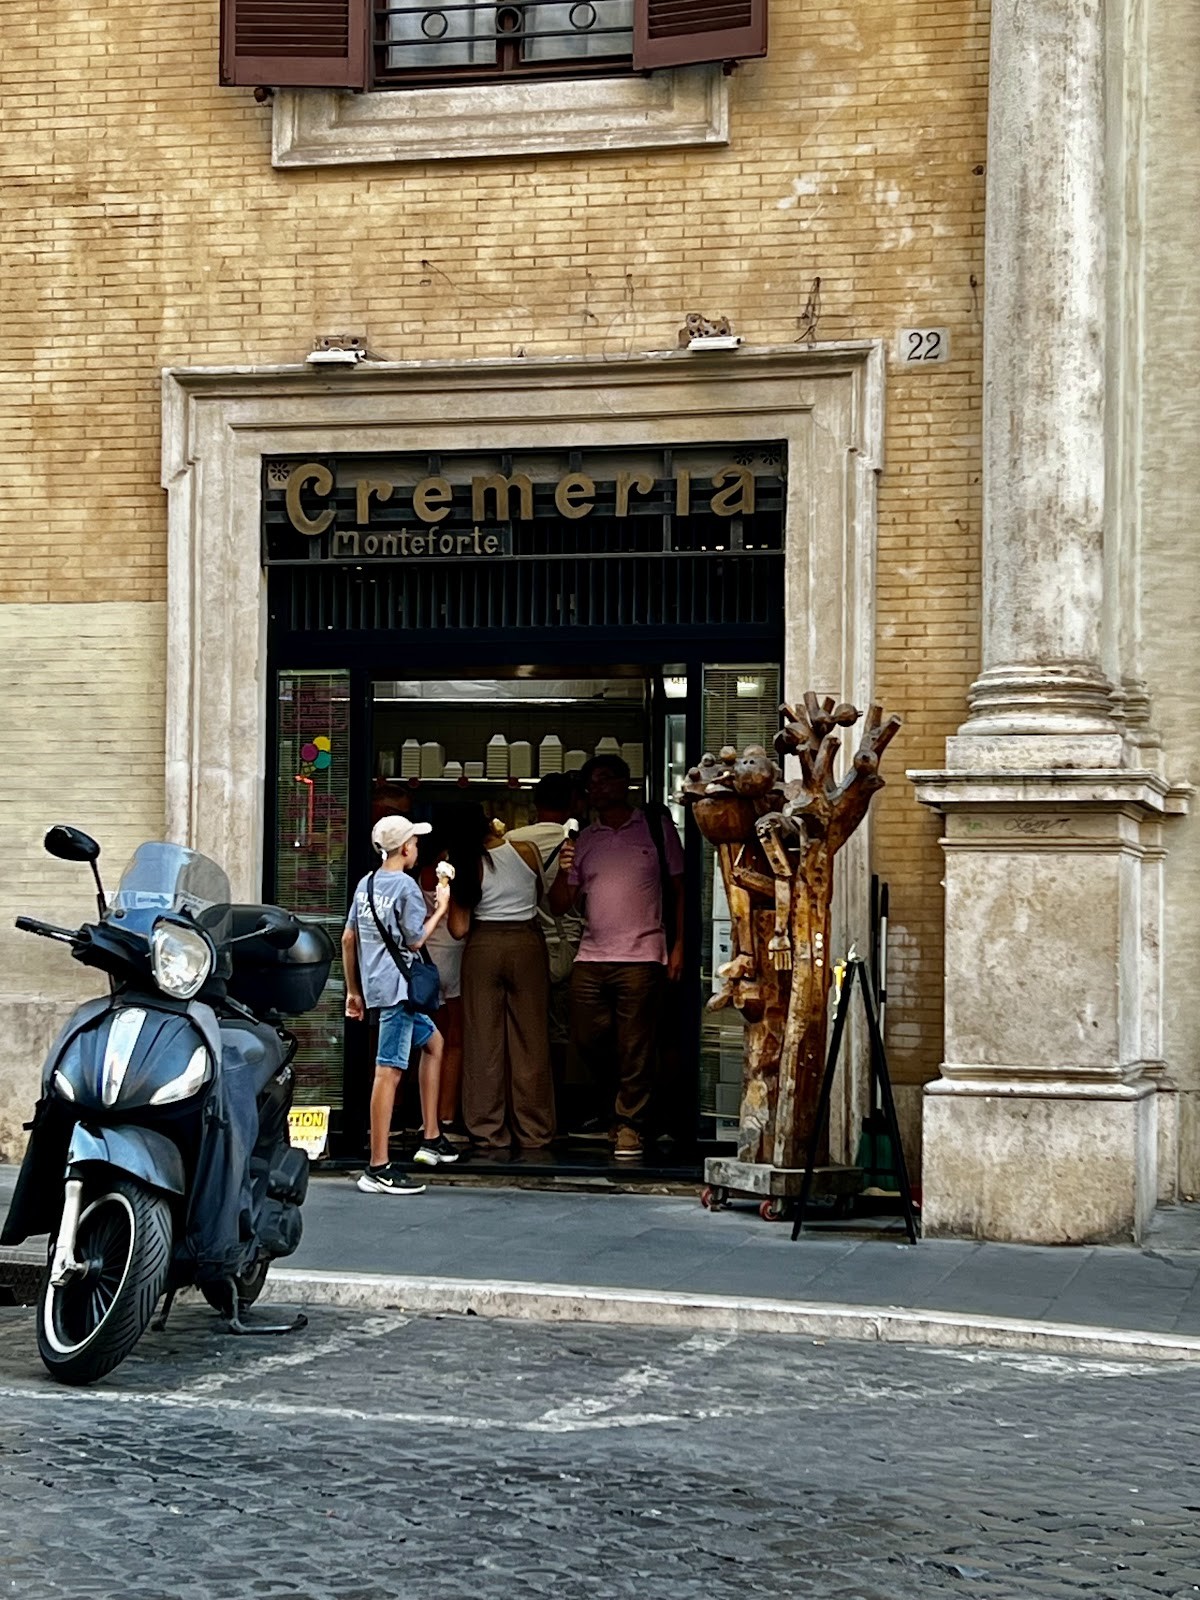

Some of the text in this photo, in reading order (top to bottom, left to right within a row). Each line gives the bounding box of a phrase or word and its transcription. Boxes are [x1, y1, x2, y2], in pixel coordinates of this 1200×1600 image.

[907, 332, 941, 361] 22
[285, 462, 757, 536] Cremeria
[289, 1112, 324, 1127] TION
